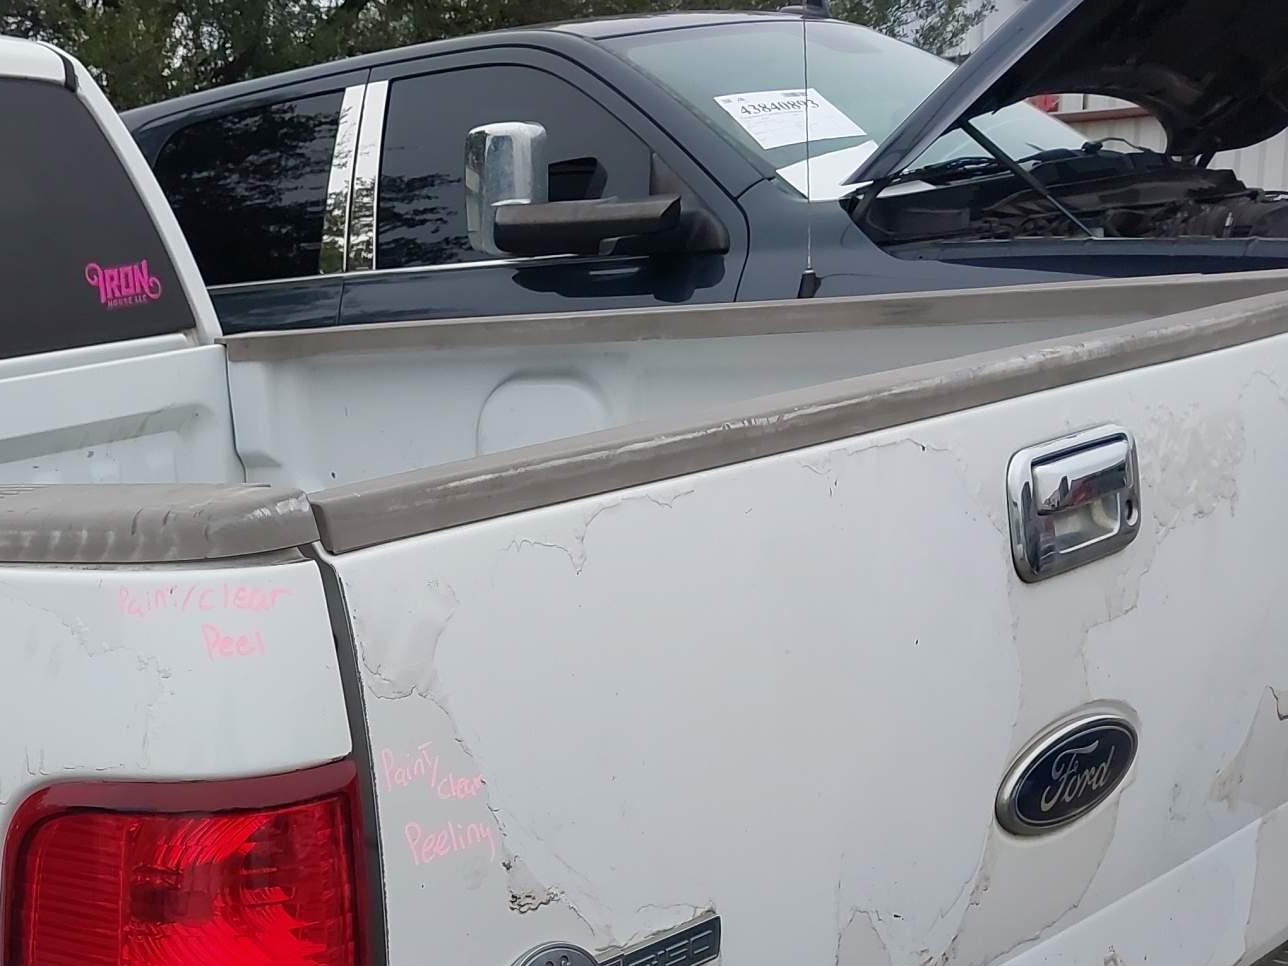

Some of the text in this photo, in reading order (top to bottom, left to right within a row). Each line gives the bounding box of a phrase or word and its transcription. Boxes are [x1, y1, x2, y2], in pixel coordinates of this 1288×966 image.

[85, 259, 162, 304] IRON
[202, 623, 266, 662] Peel
[1040, 740, 1116, 812] Ford
